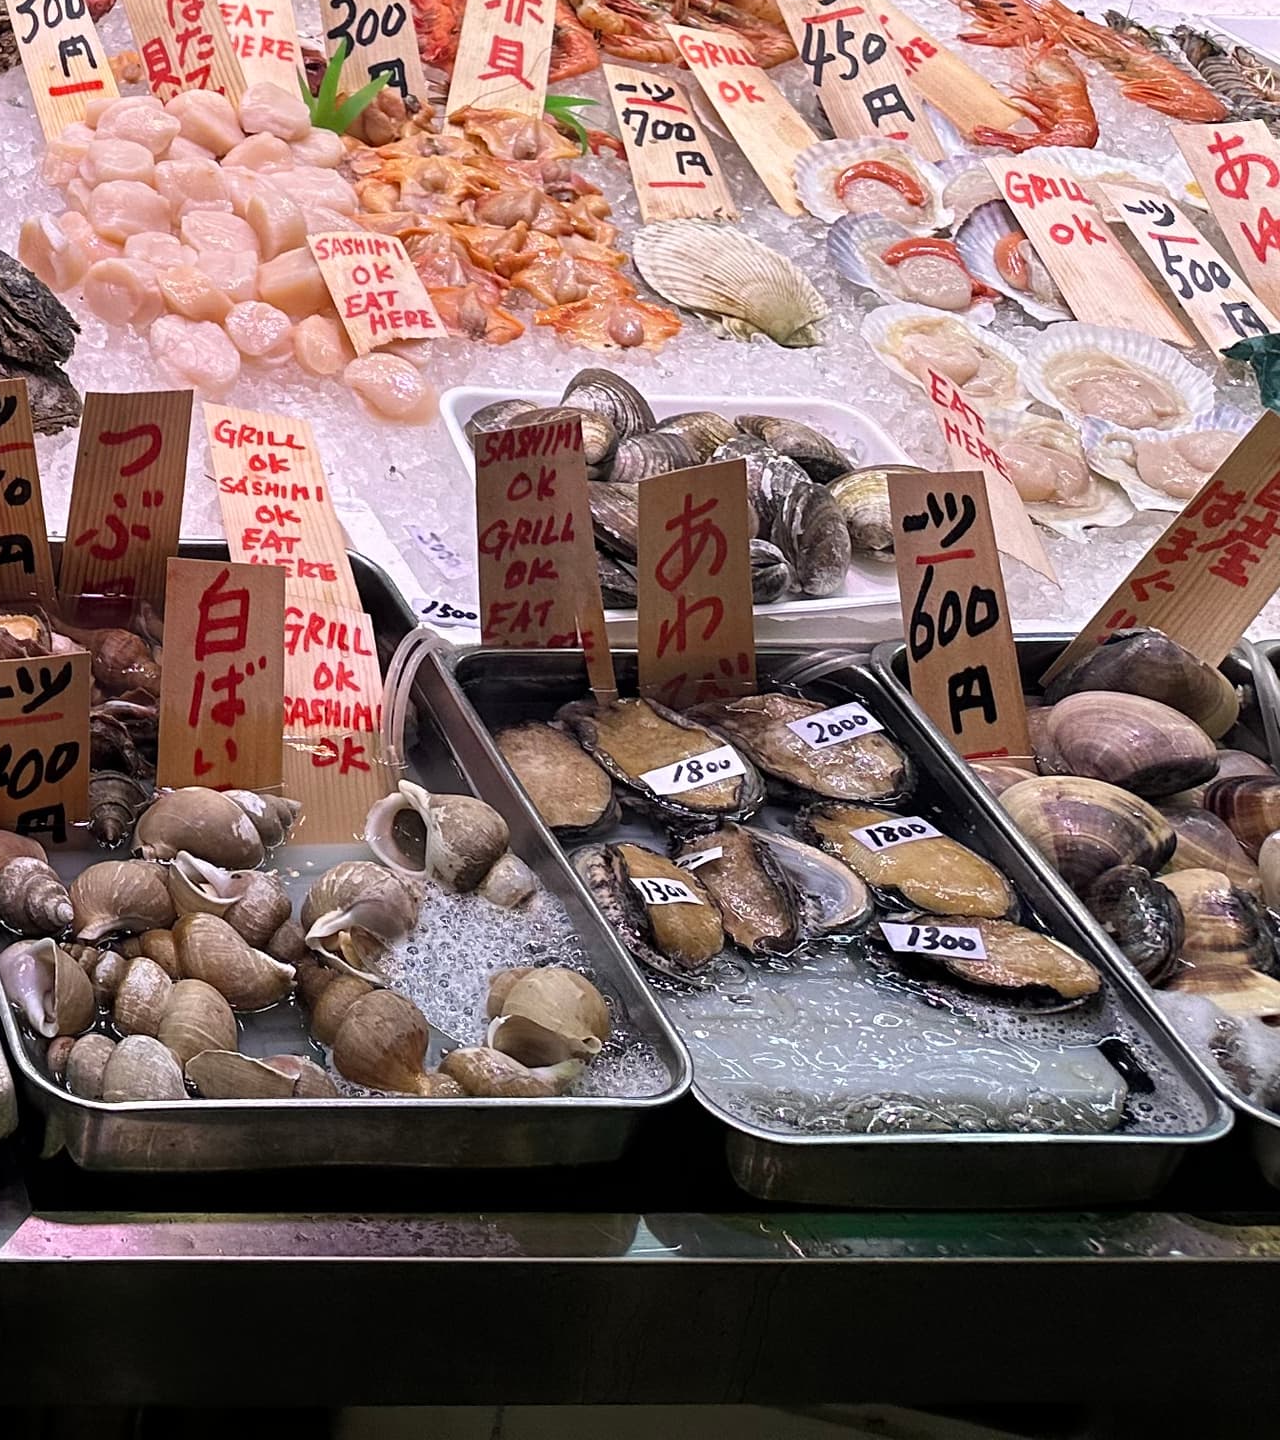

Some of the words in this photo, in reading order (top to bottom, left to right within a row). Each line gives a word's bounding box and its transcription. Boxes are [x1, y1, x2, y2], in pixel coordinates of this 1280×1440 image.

[800, 19, 887, 86] 450
[1004, 171, 1094, 206] GRILL
[1049, 214, 1107, 244] OK
[315, 237, 403, 260] SASHIMI
[1158, 237, 1231, 299] 500
[369, 311, 436, 334] HERE
[214, 419, 306, 450] GRILL
[249, 454, 292, 475] OK
[219, 476, 325, 503] SASHIMI
[255, 506, 302, 527] OK
[479, 513, 574, 557] GRILL
[909, 565, 1000, 663] 600
[812, 713, 869, 744] 2000
[671, 758, 731, 784] 1800
[866, 822, 928, 848] 1800
[906, 926, 977, 952] 1300
